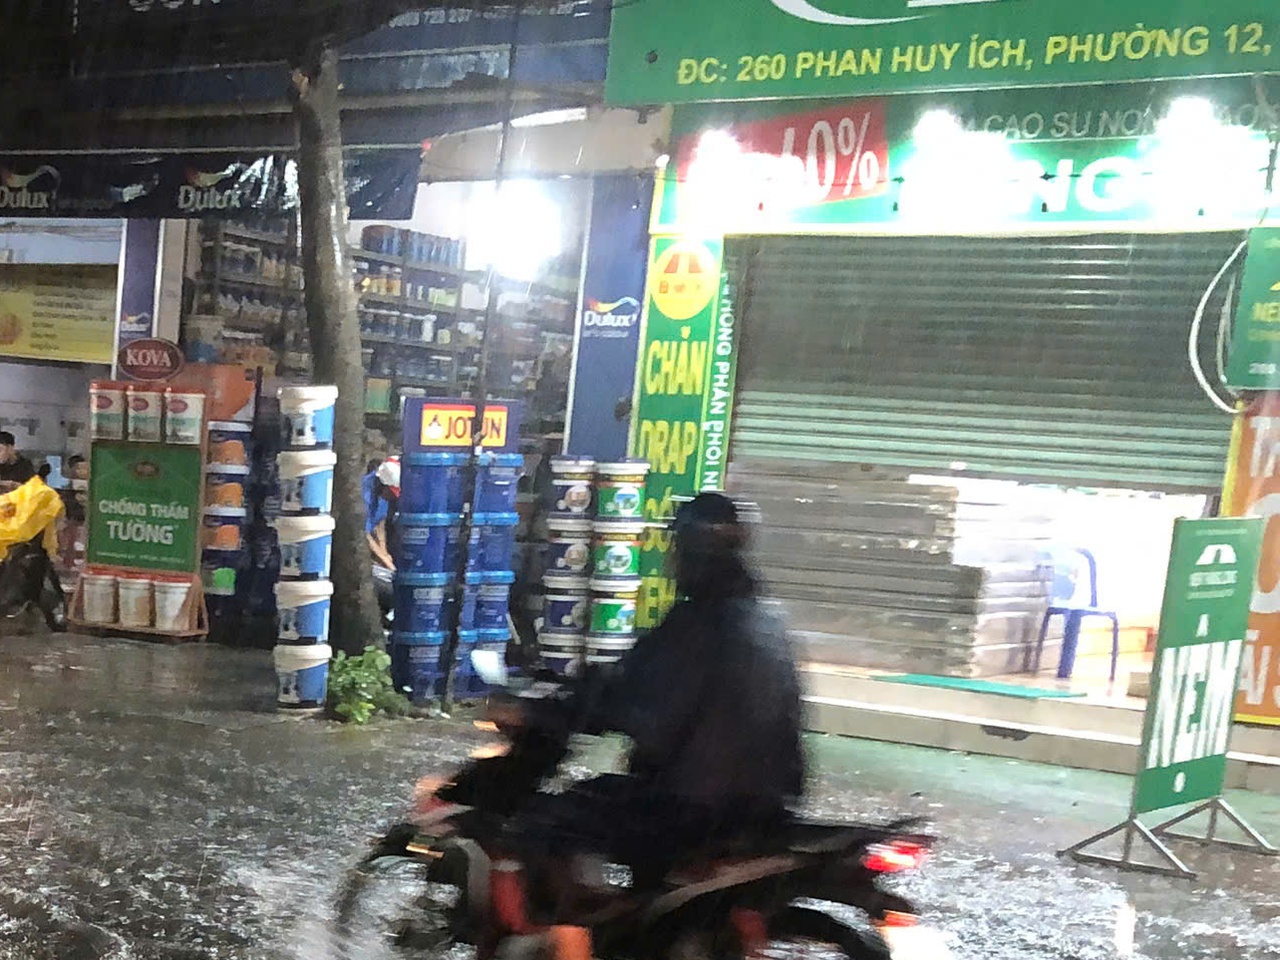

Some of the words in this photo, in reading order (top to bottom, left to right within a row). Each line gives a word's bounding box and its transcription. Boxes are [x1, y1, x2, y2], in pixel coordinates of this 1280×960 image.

[677, 57, 728, 85] ĐC:
[736, 54, 787, 82] 260
[795, 47, 883, 79] PHAN
[890, 42, 961, 73] HUY
[967, 33, 1033, 71] ÍCH,
[1044, 22, 1210, 65] PHƯỜNG
[1224, 22, 1271, 56] 12,
[984, 112, 1045, 139] CAO
[1049, 110, 1092, 138] SU
[584, 311, 634, 328] Dulux
[126, 349, 172, 367] KOVA
